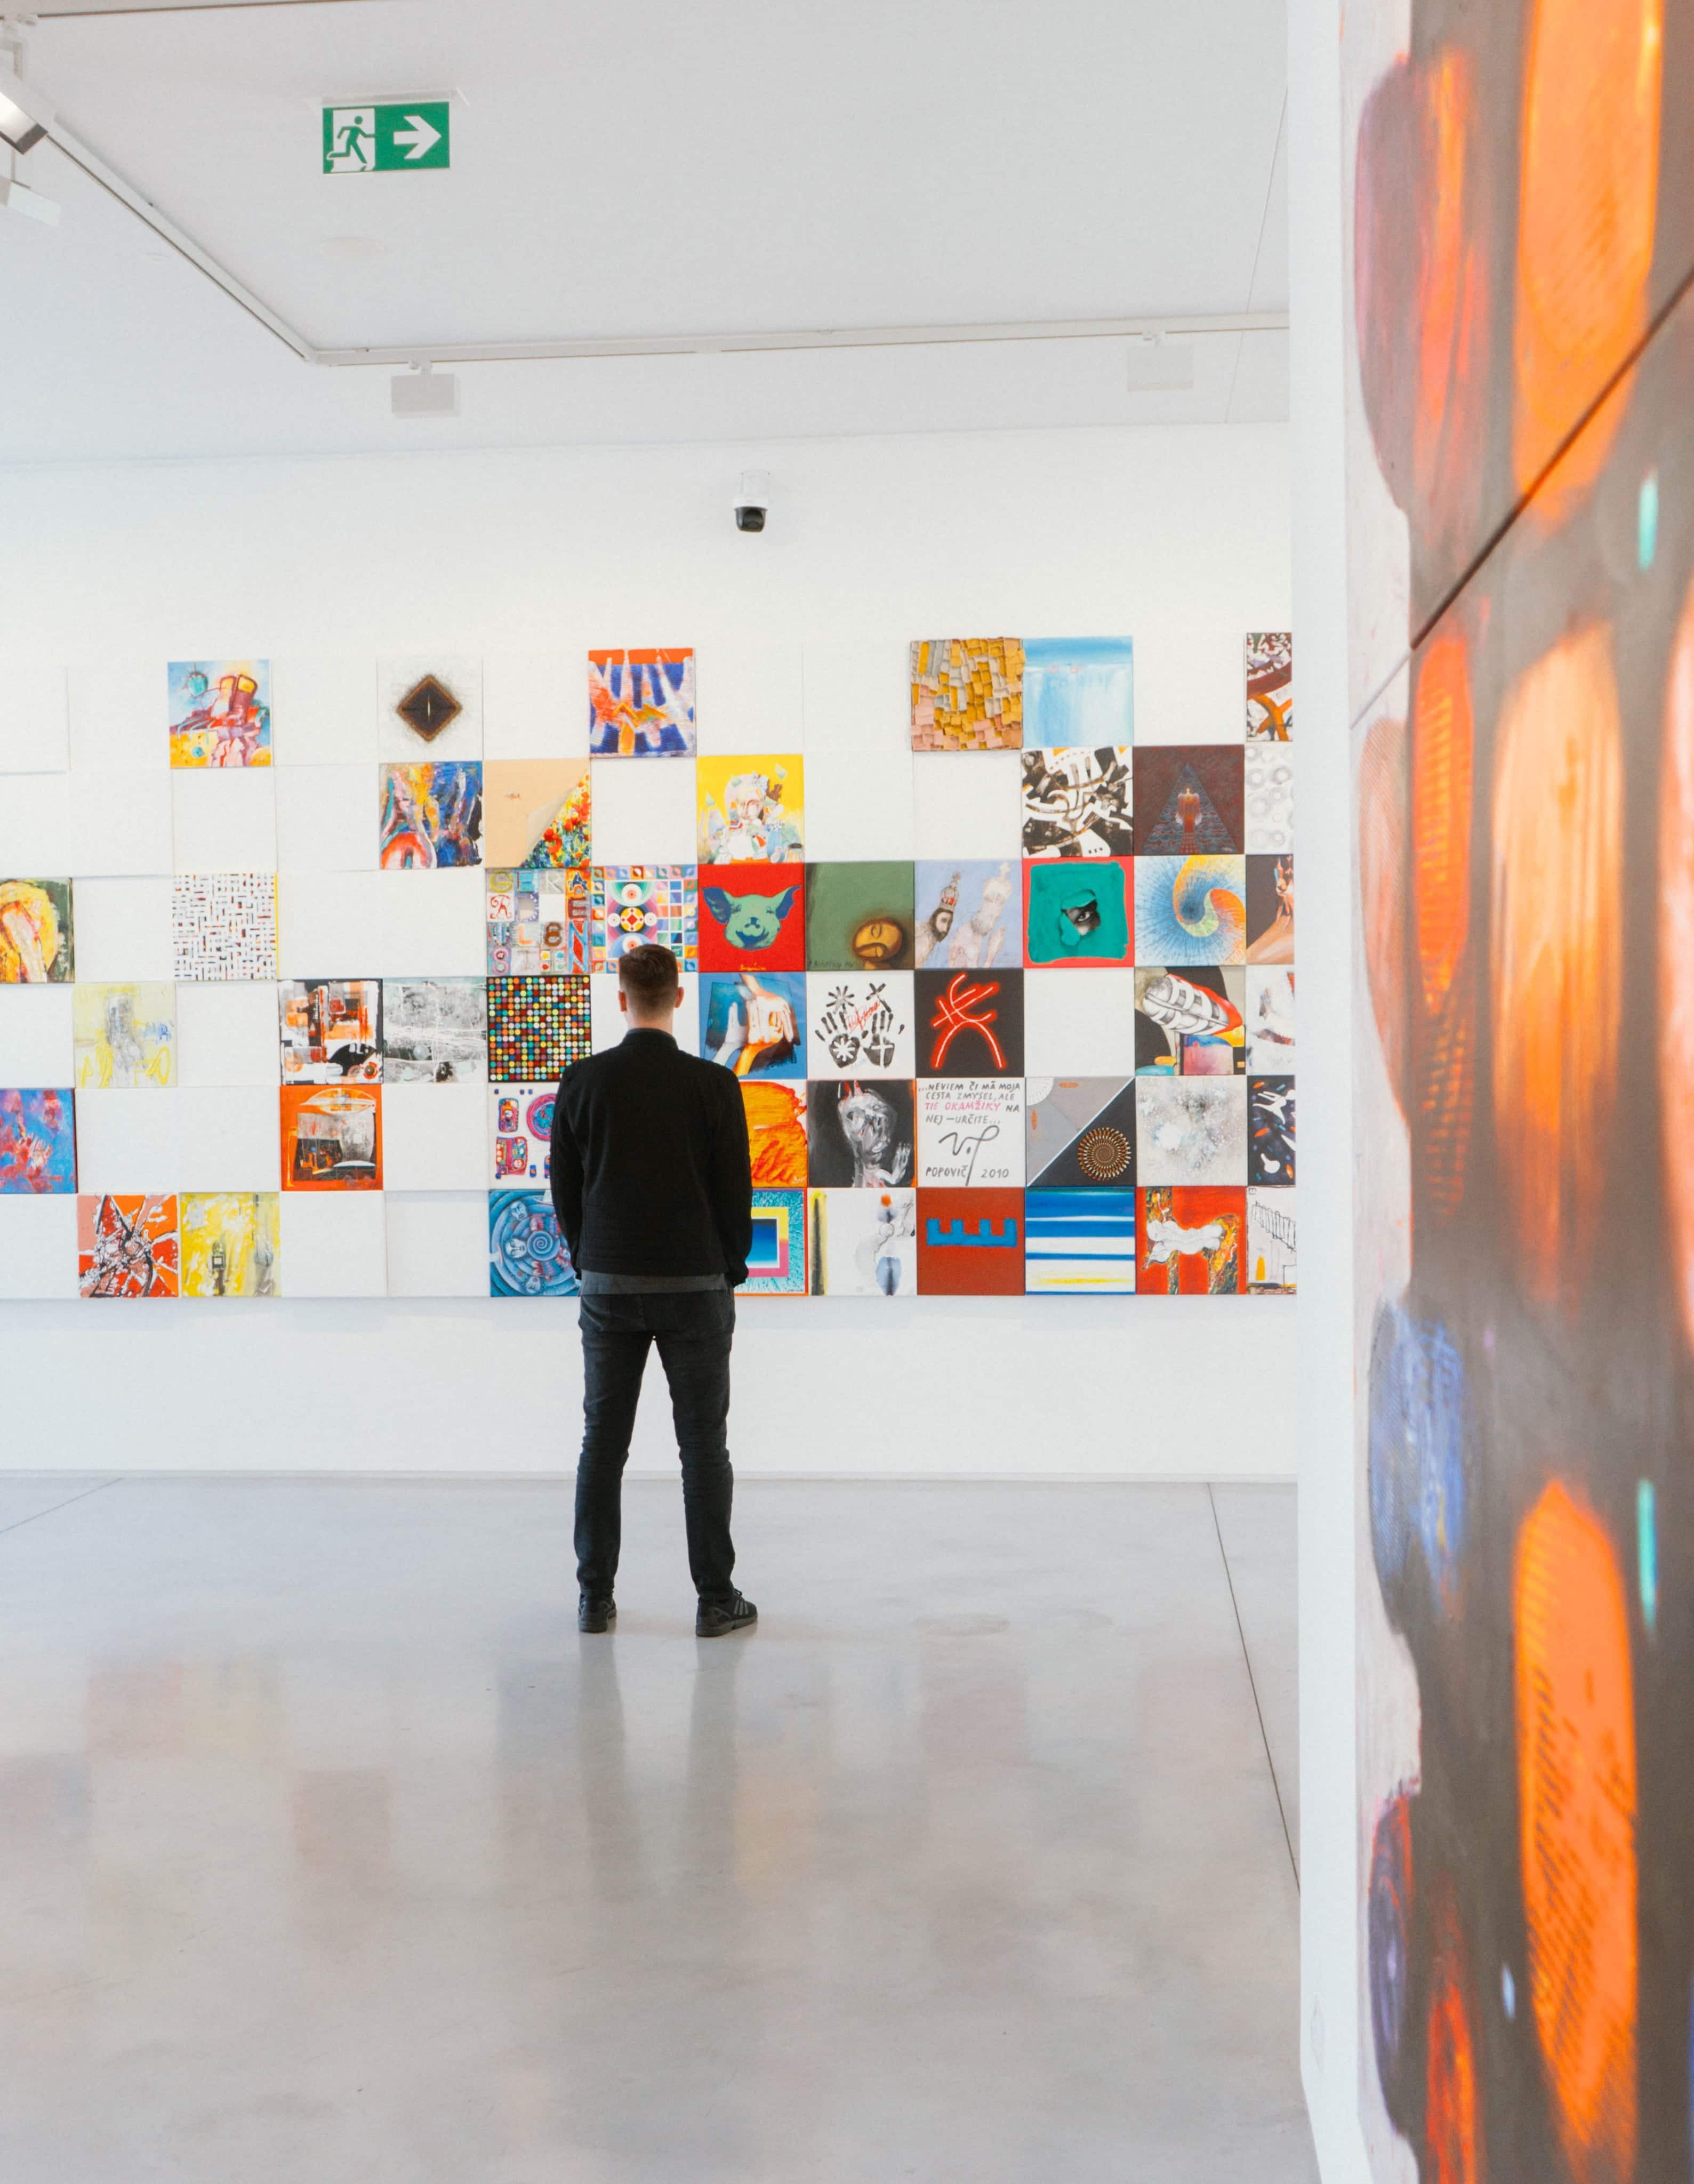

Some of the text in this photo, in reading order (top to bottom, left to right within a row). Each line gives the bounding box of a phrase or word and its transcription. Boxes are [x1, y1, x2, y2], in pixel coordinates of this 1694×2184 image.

[999, 1083, 1020, 1093] MOJA
[945, 1101, 1001, 1111] OKAMŽIKY
[926, 1115, 943, 1126] NEJ
[926, 1165, 1009, 1178] POPOVIČ 2010
